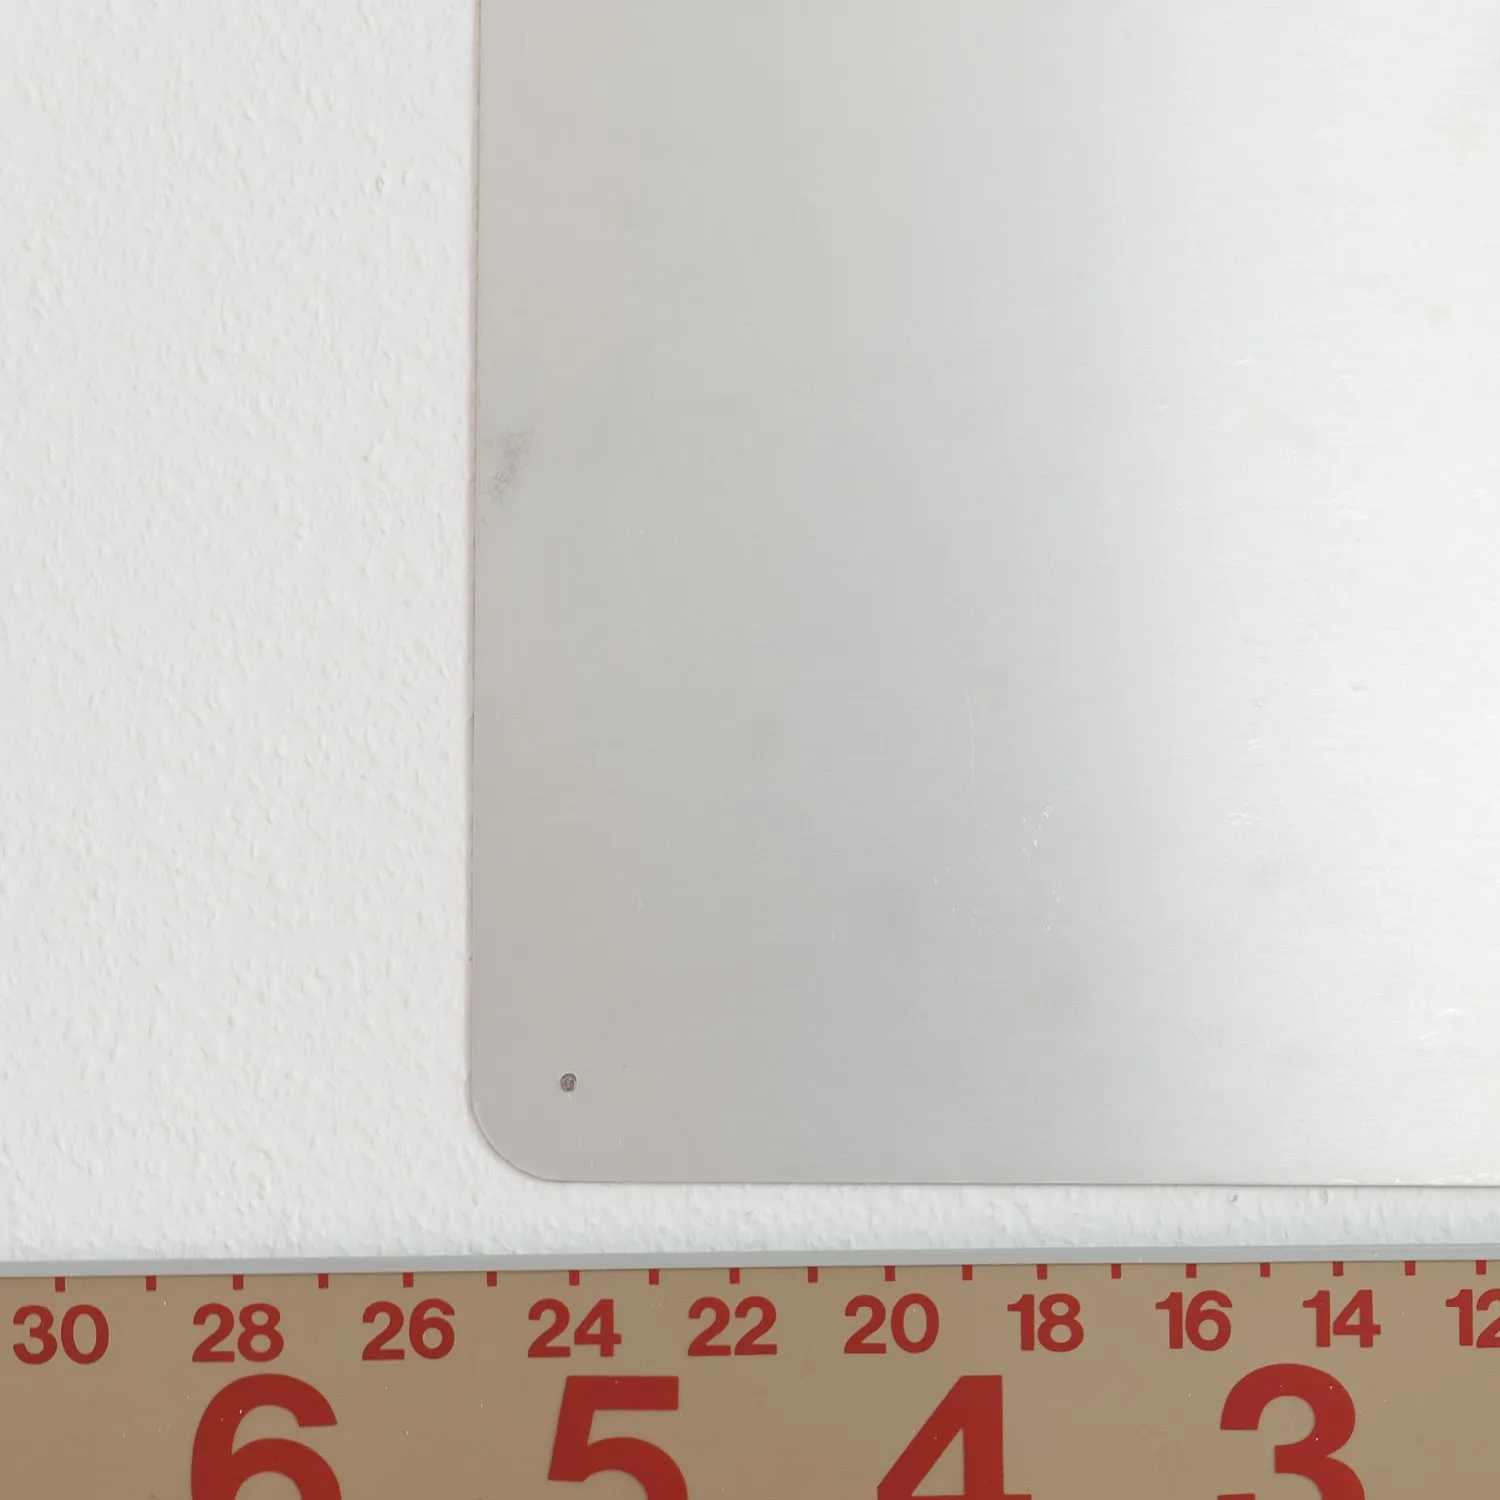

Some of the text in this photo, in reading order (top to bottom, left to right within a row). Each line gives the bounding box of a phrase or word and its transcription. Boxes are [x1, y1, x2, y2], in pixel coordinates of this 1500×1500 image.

[13, 1304, 109, 1365] 30
[193, 1303, 284, 1362] 28
[362, 1298, 455, 1360] 26
[528, 1298, 623, 1358] 24
[688, 1295, 777, 1357] 22
[844, 1293, 939, 1354] 20
[1007, 1293, 1084, 1353] 18
[1156, 1290, 1233, 1351] 16
[1303, 1289, 1381, 1348] 14
